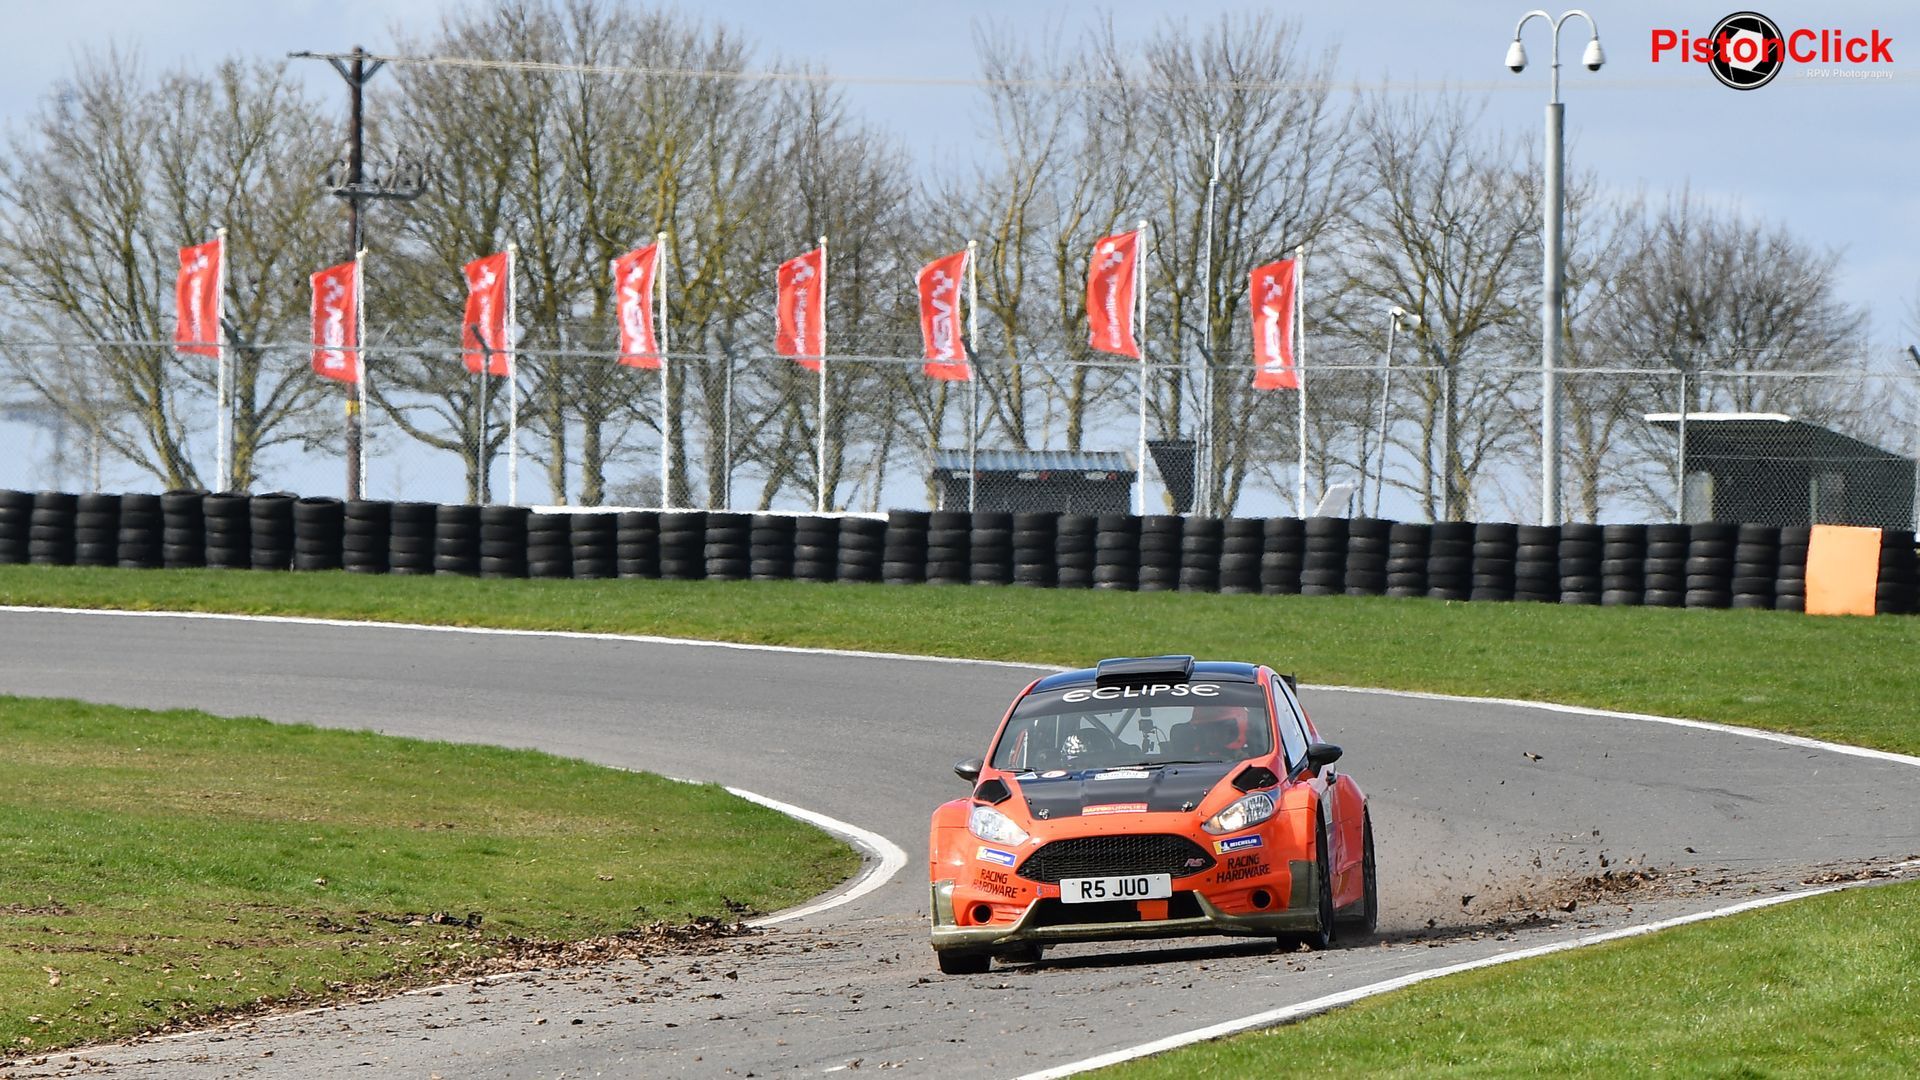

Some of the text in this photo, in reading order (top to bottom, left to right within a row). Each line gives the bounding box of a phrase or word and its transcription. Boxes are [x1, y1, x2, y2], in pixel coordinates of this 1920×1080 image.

[1062, 683, 1221, 703] ECLIPSE
[1227, 855, 1260, 870] RACING
[980, 869, 1008, 884] RACING
[1216, 864, 1271, 884] HARDWARE
[971, 879, 1018, 898] HARDWARE
[1081, 880, 1106, 899] R5
[1112, 878, 1149, 897] JUO
